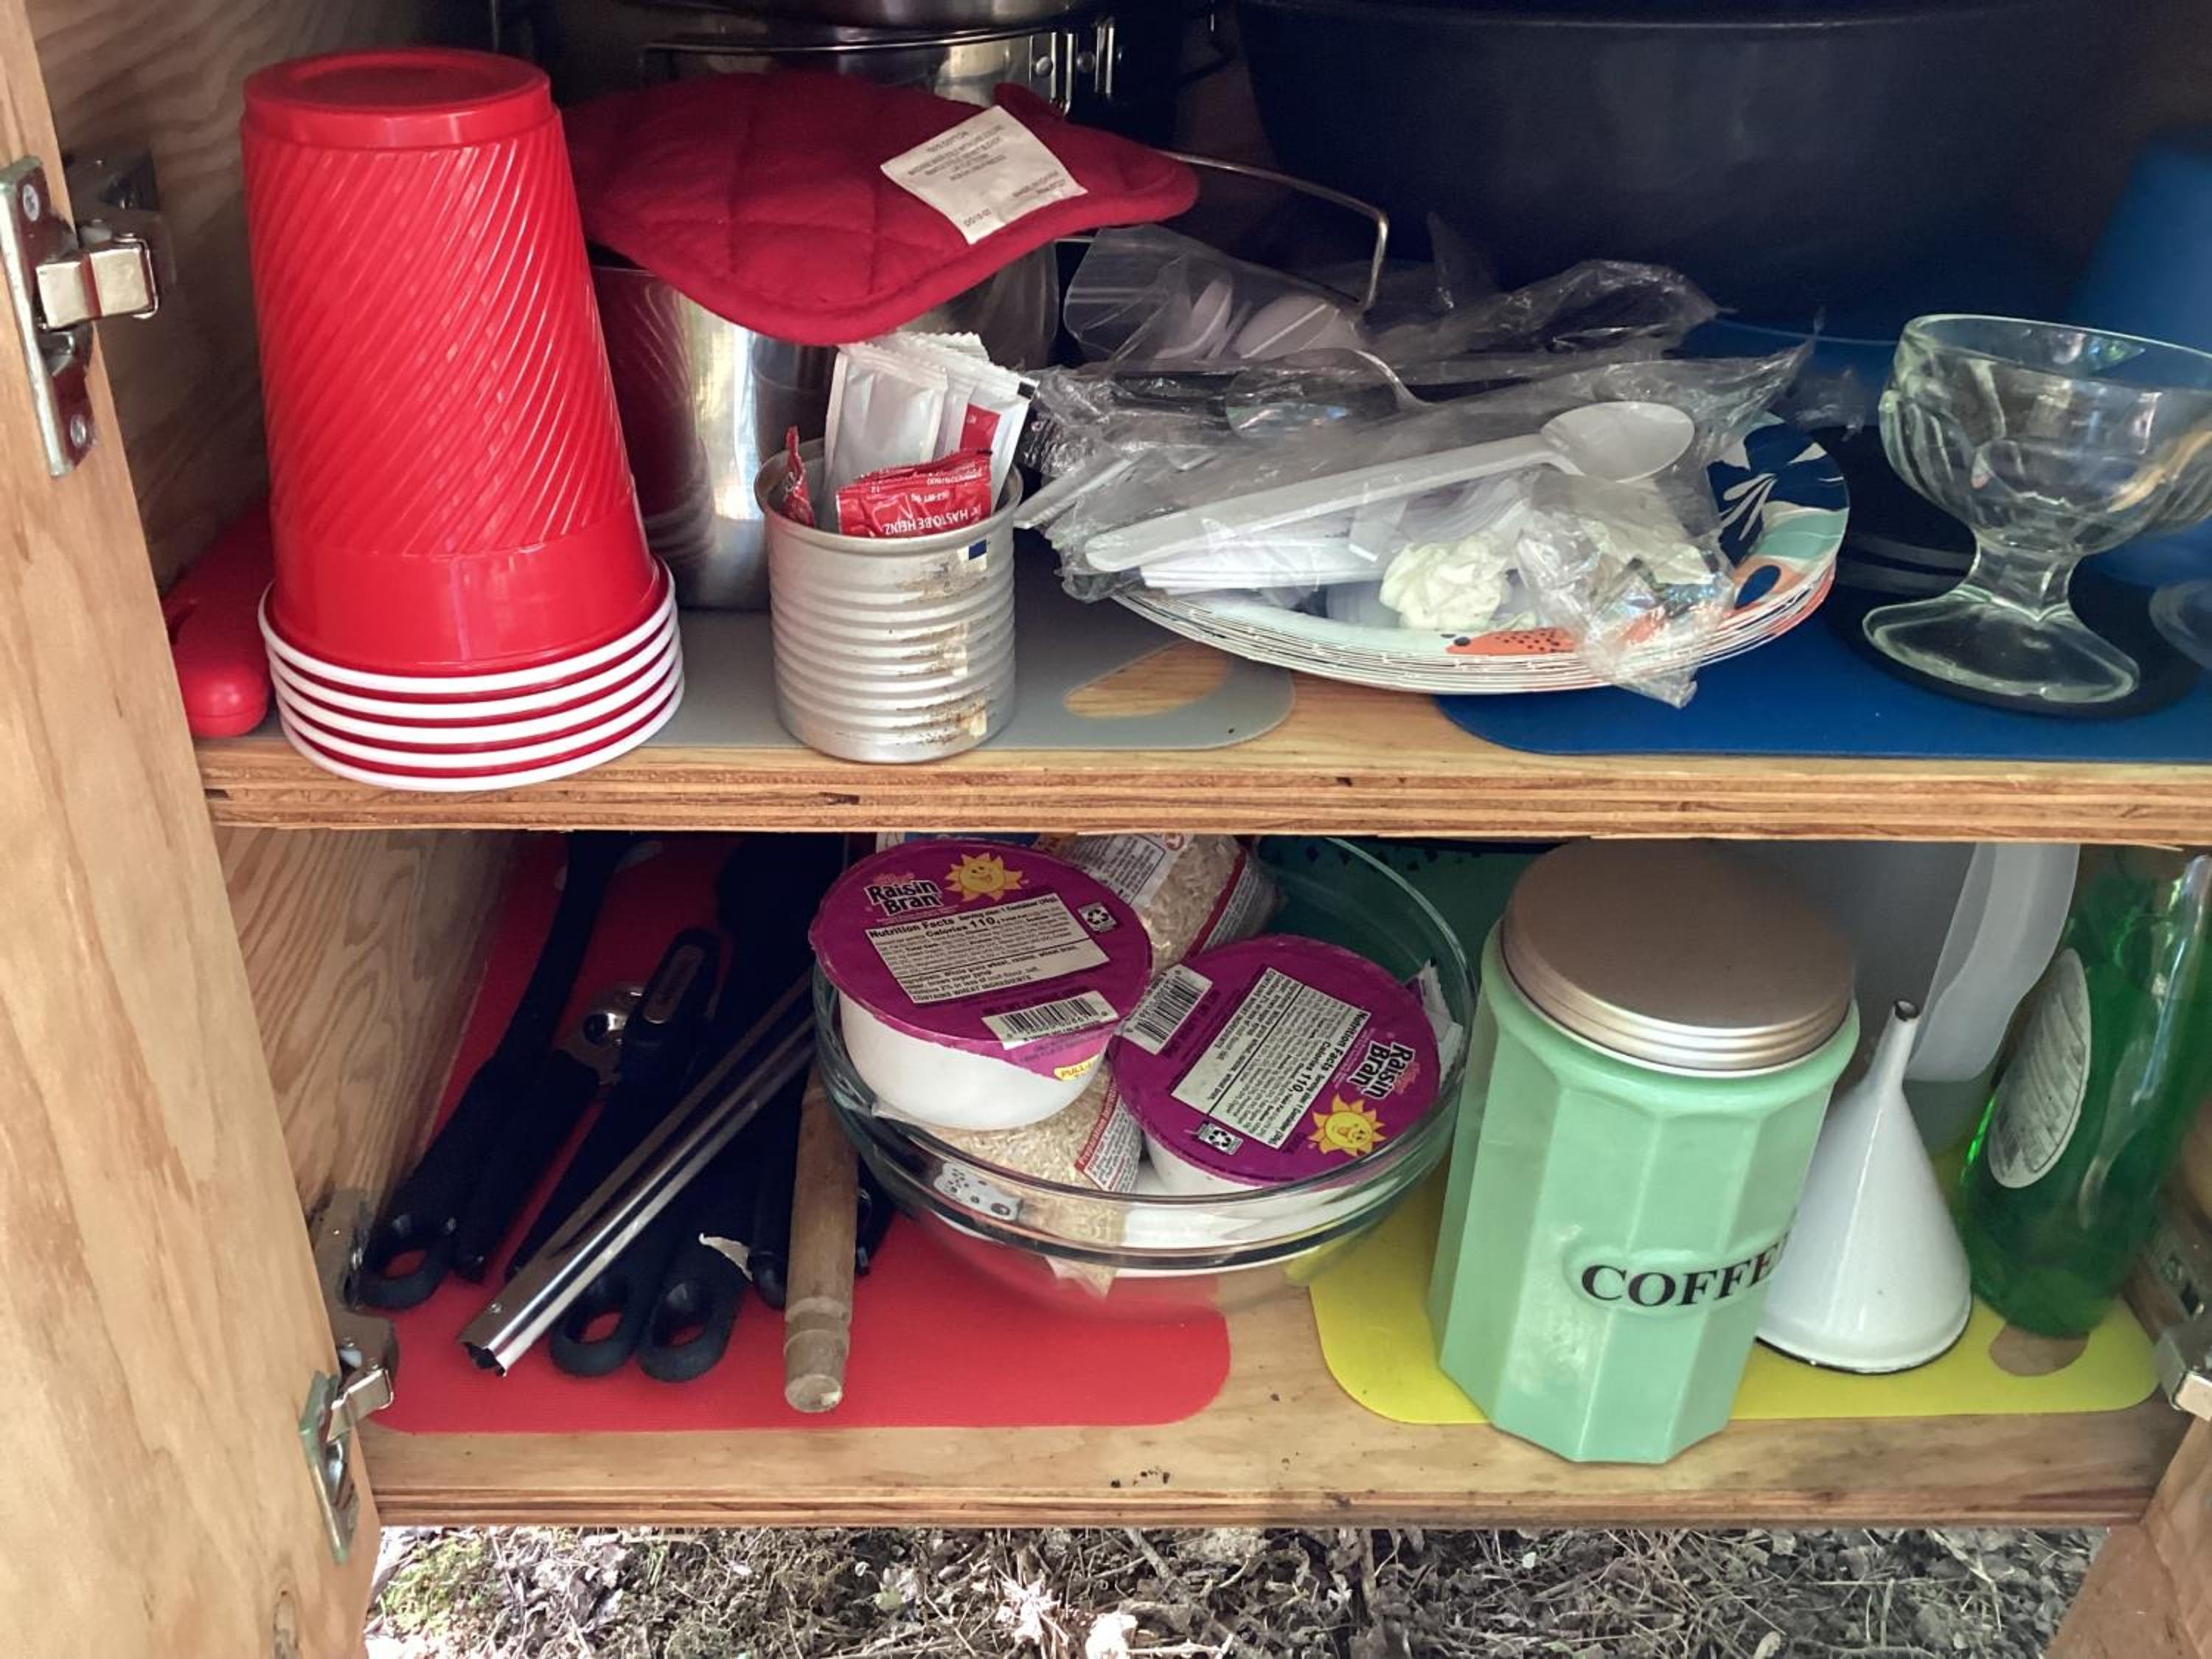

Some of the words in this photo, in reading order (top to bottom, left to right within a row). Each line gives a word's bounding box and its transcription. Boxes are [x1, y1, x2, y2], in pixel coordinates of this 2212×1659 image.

[884, 518, 914, 535] HEINZ
[914, 516, 932, 529] BE
[944, 507, 970, 522] HAS
[866, 880, 939, 903] Raisin
[883, 895, 939, 914] Bran
[867, 922, 921, 939] Nutrition
[920, 917, 956, 929] Facts
[924, 924, 968, 937] Calories
[967, 916, 1001, 928] 110,
[1336, 1011, 1368, 1048] Nutrition
[1304, 1040, 1332, 1072] Calories
[1319, 1046, 1343, 1073] Facts
[1350, 1043, 1383, 1093] Bran
[1365, 1043, 1413, 1098] Raisin
[1287, 1071, 1312, 1096] 110,
[1078, 1118, 1107, 1166] Preparation
[1582, 1234, 1788, 1307] COFFE
